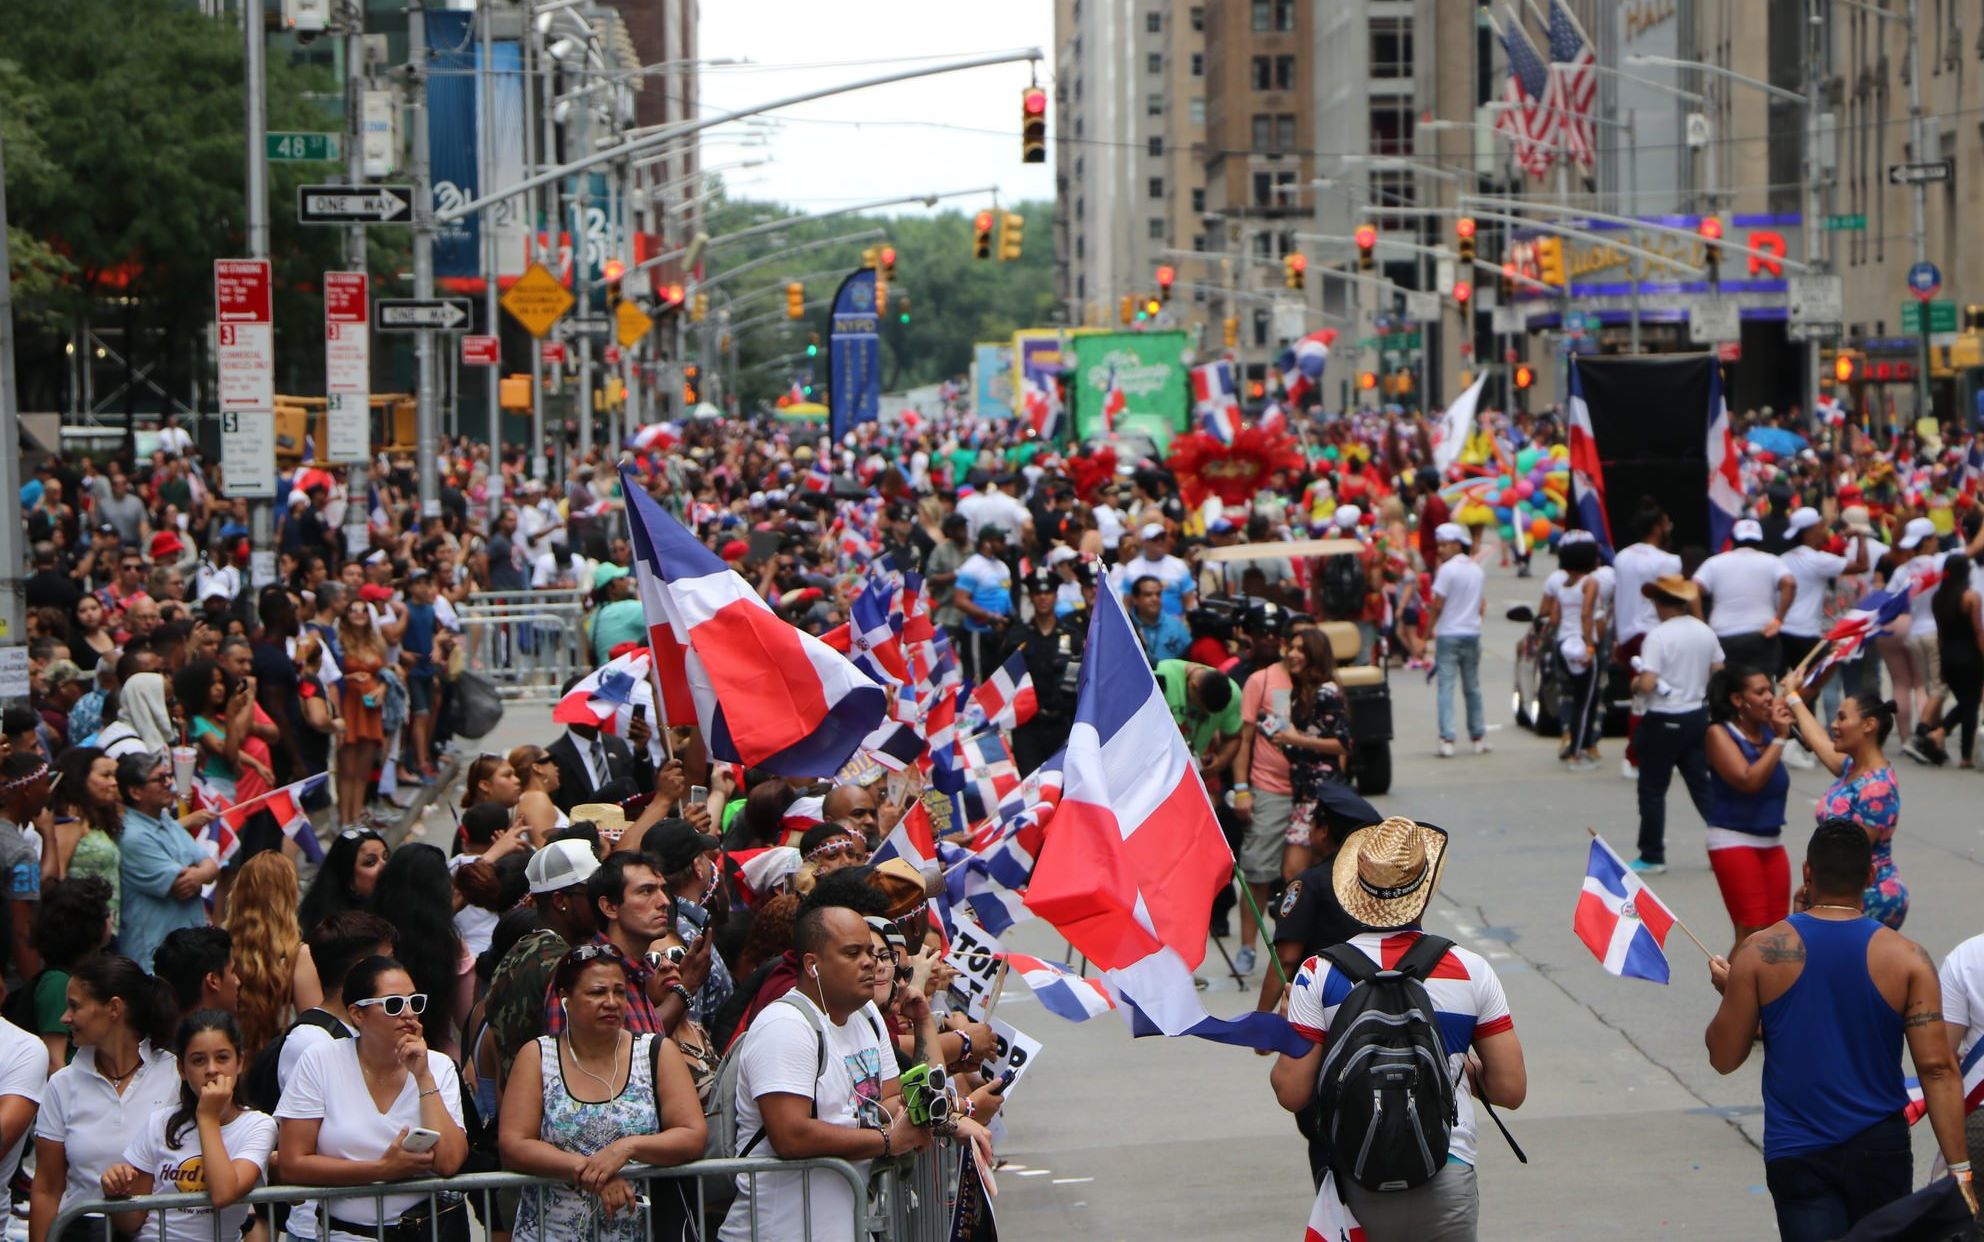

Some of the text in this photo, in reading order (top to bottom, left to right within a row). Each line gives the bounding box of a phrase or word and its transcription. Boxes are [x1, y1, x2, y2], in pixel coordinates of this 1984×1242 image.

[277, 134, 305, 158] 48
[315, 196, 395, 211] ONE WAY
[1747, 231, 1787, 277] R
[391, 308, 456, 319] ONE WAY
[223, 325, 234, 344] 3
[834, 319, 877, 333] NYPD
[225, 413, 236, 431] 5
[160, 1164, 201, 1182] Hard
